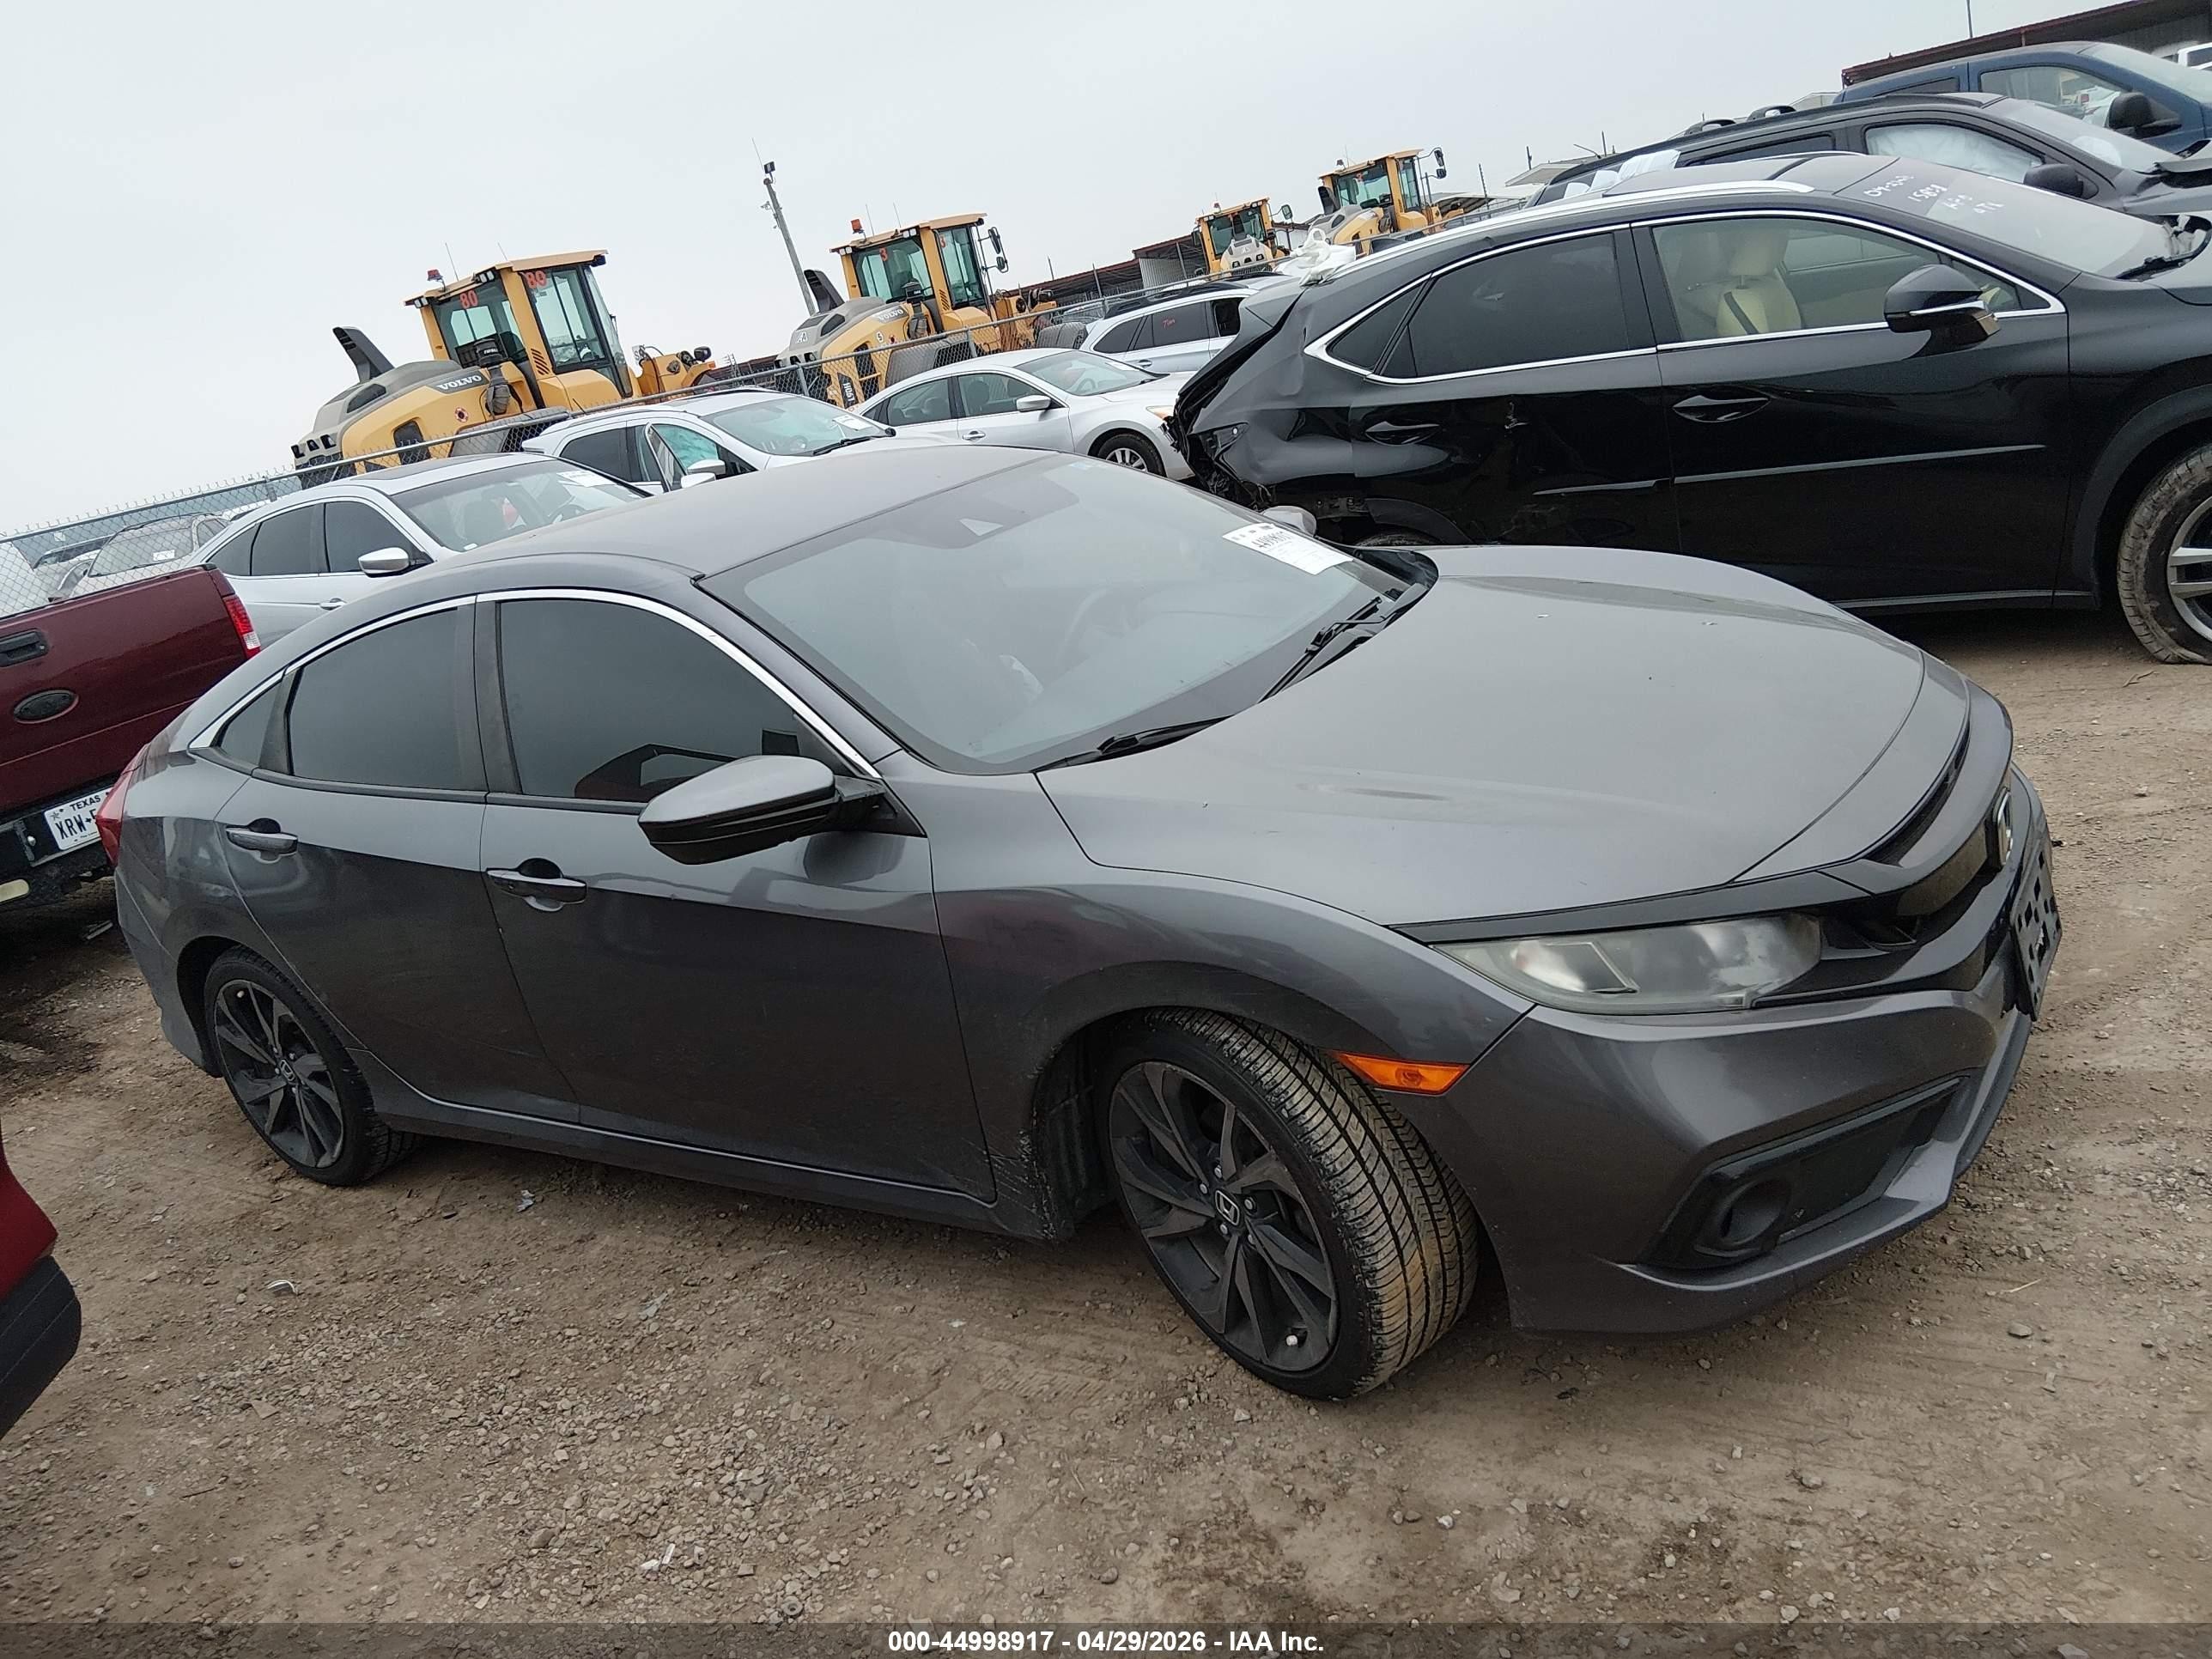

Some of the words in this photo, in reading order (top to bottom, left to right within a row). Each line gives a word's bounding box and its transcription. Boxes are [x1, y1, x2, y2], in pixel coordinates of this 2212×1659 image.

[526, 270, 547, 289] 80
[460, 290, 478, 309] 80
[878, 309, 904, 320] VOLVO
[436, 375, 482, 390] VOLVO
[70, 795, 101, 811] TEXAS
